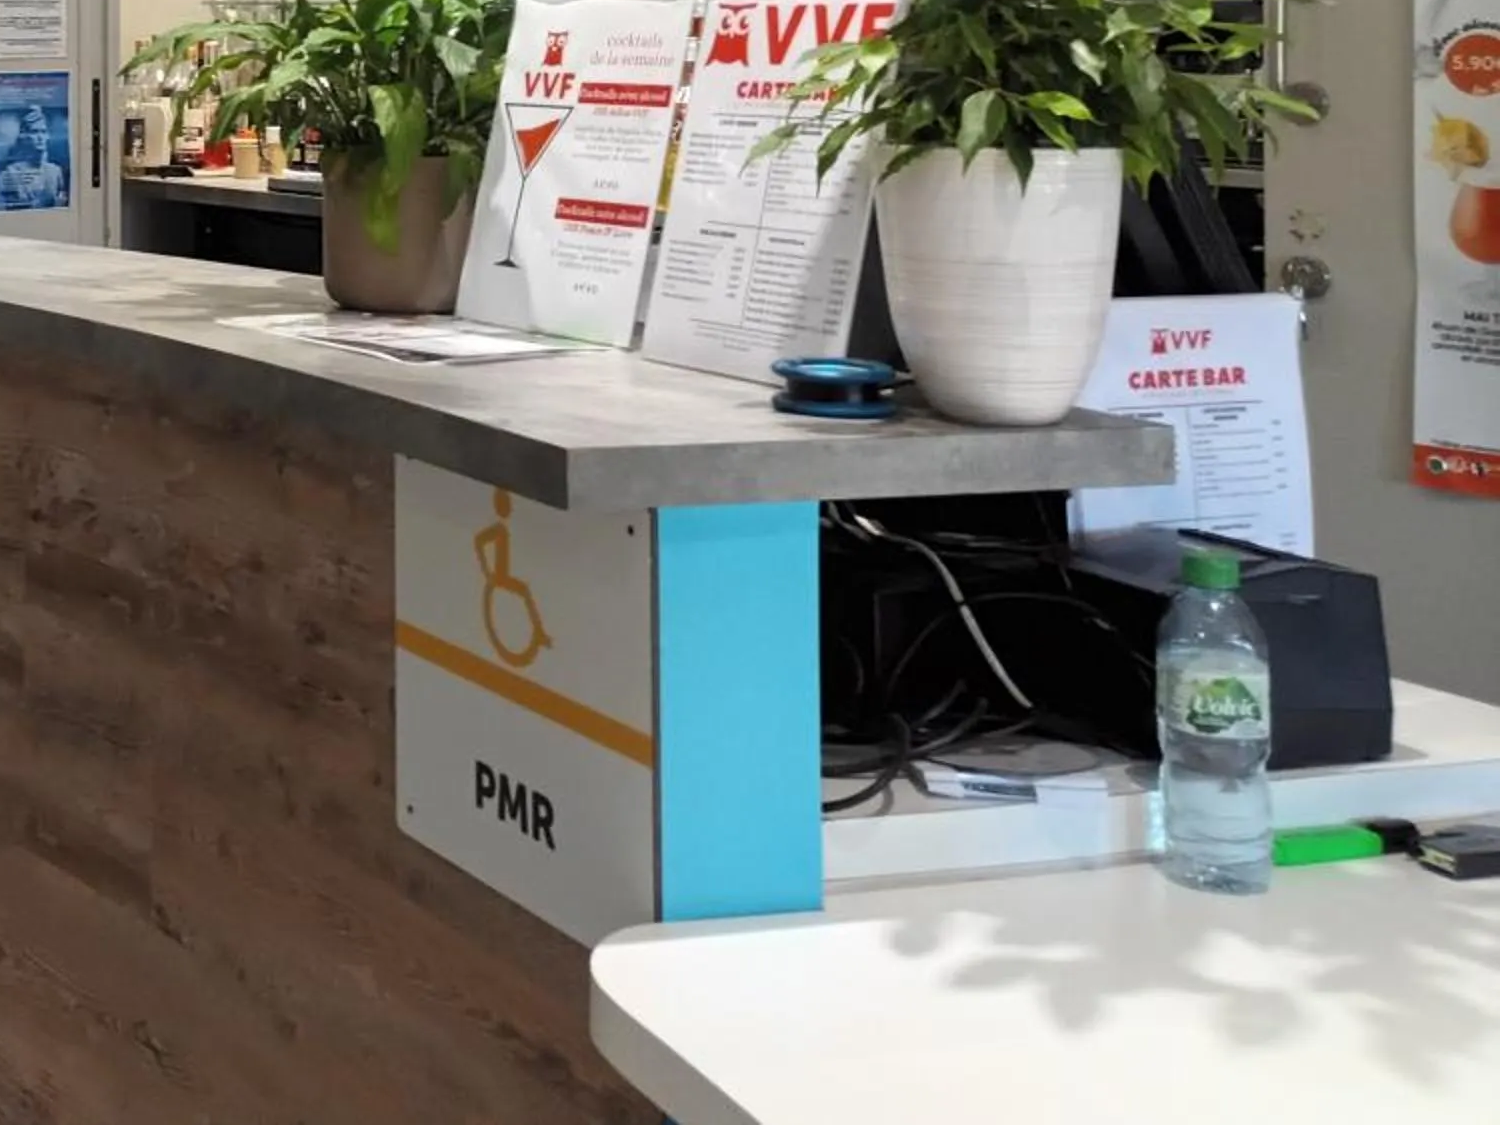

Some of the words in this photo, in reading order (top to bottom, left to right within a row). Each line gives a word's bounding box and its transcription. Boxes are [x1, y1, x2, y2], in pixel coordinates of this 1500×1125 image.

[765, 3, 896, 65] VVF
[523, 71, 576, 100] VVF
[1171, 329, 1213, 350] VVF
[1128, 368, 1199, 390] CARTE
[1203, 366, 1247, 386] BAR
[475, 760, 556, 851] PMR
